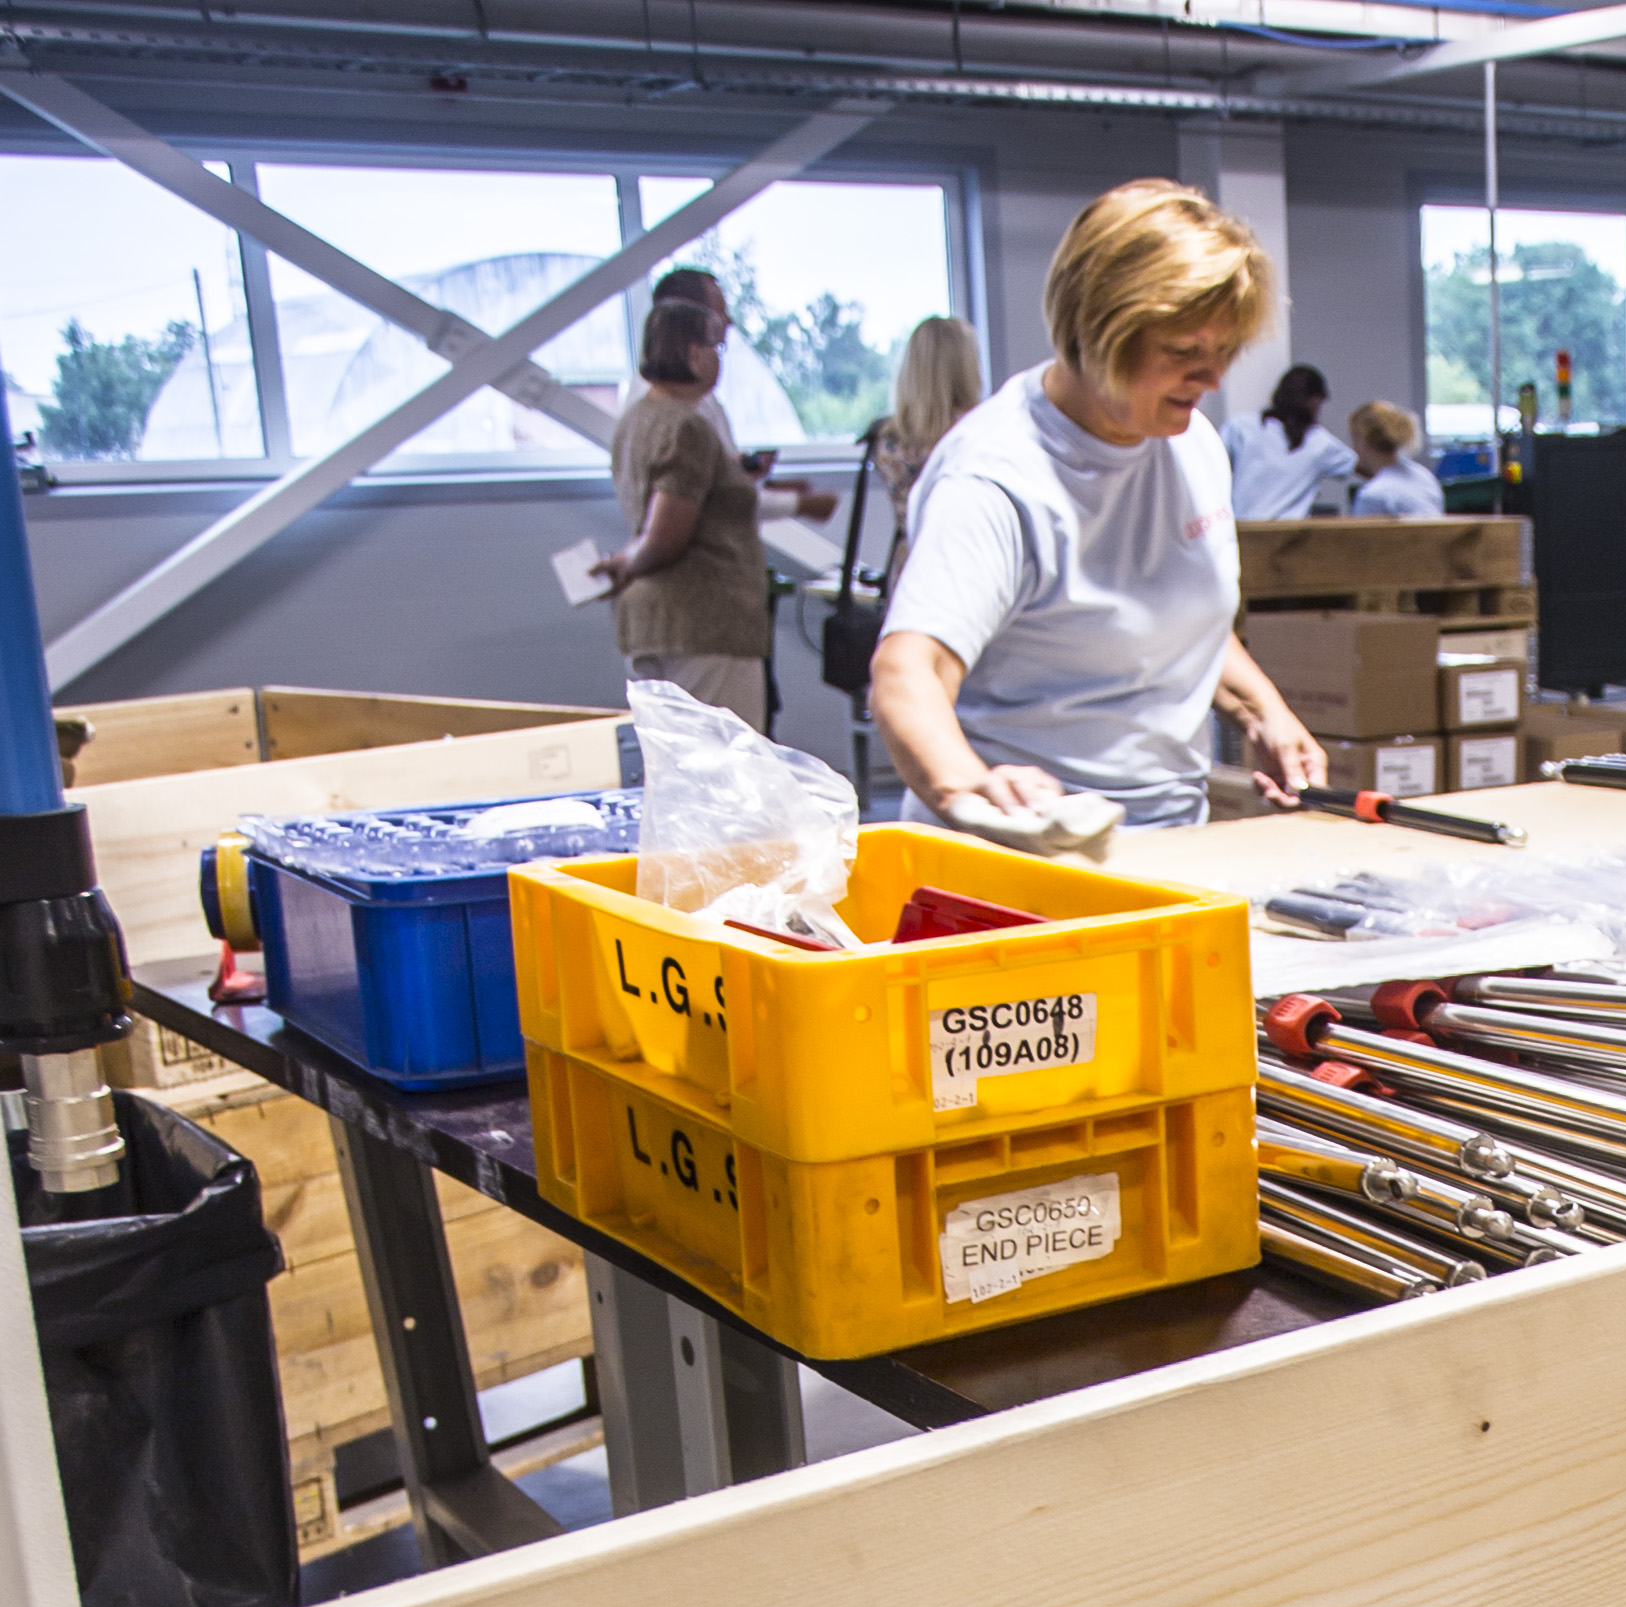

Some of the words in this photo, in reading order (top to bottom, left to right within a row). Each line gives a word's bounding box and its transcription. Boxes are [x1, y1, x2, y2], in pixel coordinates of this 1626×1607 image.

[942, 995, 1083, 1034] GSC0648
[945, 1033, 1080, 1077] (109A08)
[976, 1196, 1091, 1232] GSC0650
[962, 1239, 1017, 1266] END
[1026, 1225, 1103, 1256] PIECE
